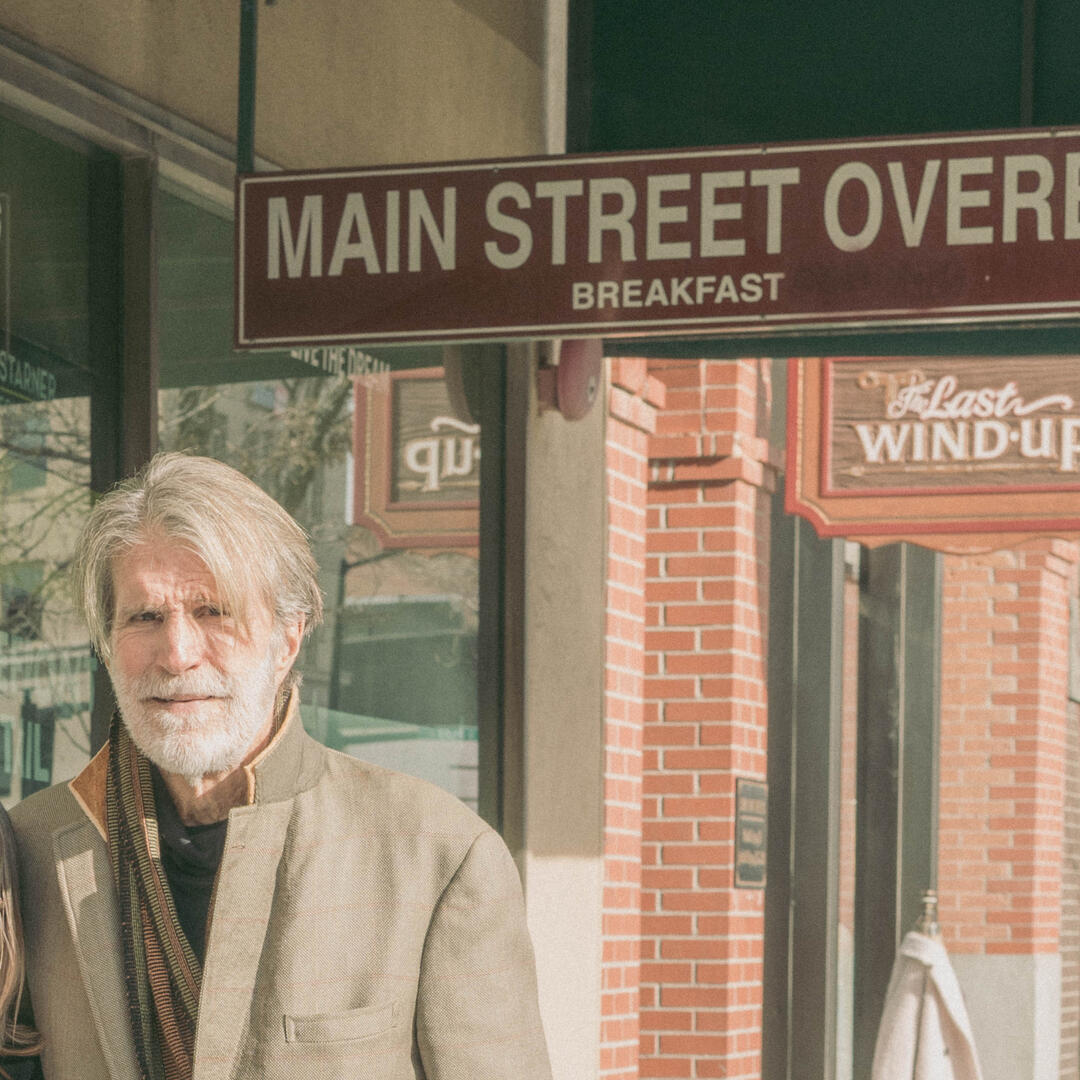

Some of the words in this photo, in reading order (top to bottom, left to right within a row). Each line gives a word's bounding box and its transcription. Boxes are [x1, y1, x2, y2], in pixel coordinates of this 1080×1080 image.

[267, 186, 457, 279] MAIN
[483, 167, 800, 270] STREET
[571, 272, 785, 310] BREAKFAST
[920, 375, 1073, 419] Last
